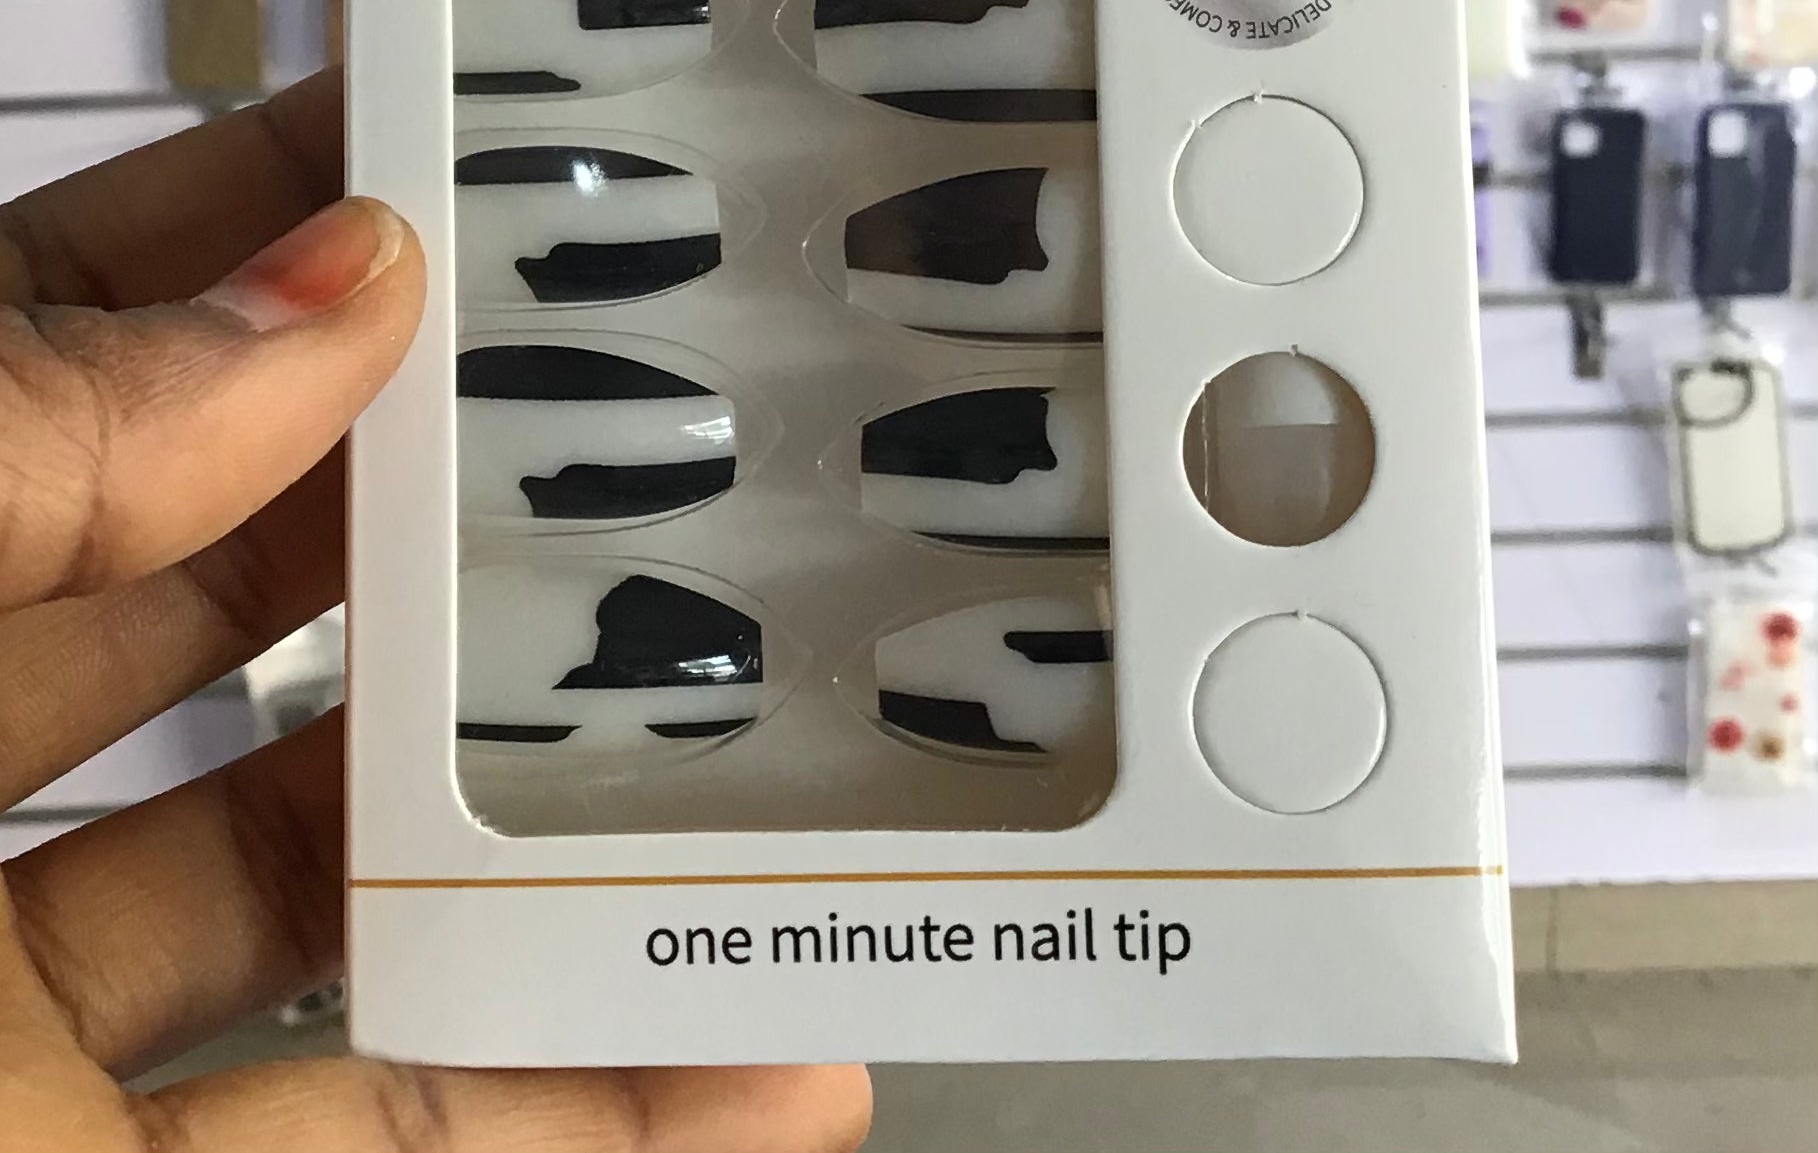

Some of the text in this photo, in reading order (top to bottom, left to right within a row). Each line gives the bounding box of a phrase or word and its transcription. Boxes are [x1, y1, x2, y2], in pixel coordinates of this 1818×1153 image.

[1226, 19, 1241, 38] &
[646, 907, 1191, 976] one minute nail tip
